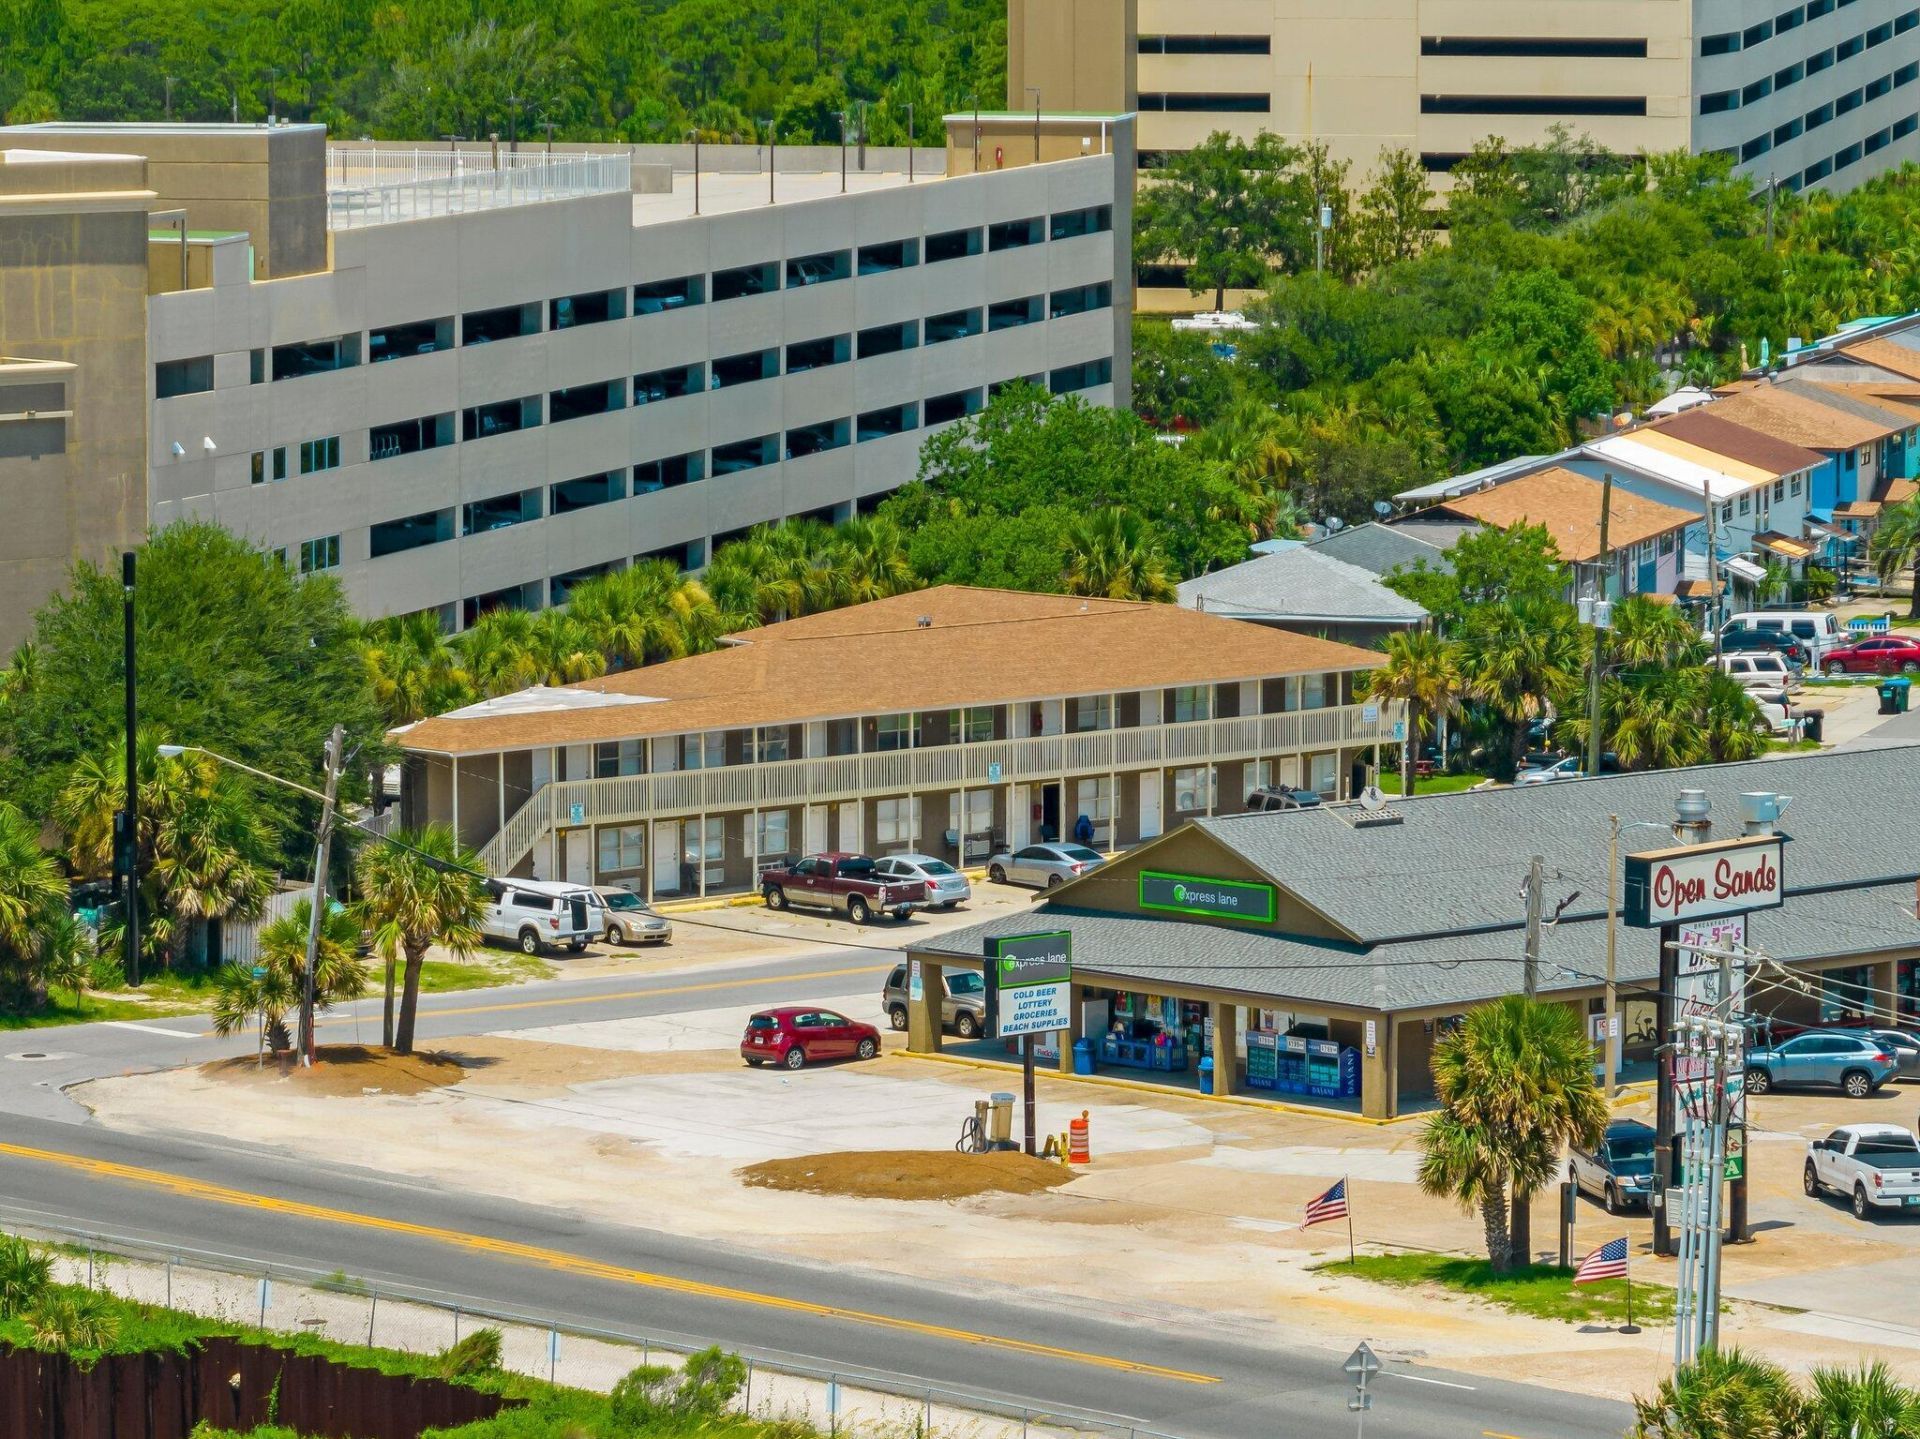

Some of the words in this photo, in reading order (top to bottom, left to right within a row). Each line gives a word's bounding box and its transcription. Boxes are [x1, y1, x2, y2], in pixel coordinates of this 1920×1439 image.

[1654, 864, 1706, 916] Open
[1713, 853, 1776, 900] Sands
[1179, 889, 1216, 903] express
[1218, 891, 1238, 906] lane
[1009, 956, 1045, 971] express
[1047, 952, 1067, 963] lane
[1013, 989, 1034, 999] COLD
[1036, 987, 1057, 997] BEER
[1018, 998, 1053, 1010] LOTTERY
[1013, 1008, 1058, 1021] GROCERIES
[1003, 1022, 1029, 1033] BEACH
[1031, 1017, 1068, 1030] SUPPLIES
[1346, 1053, 1355, 1094] DASANI
